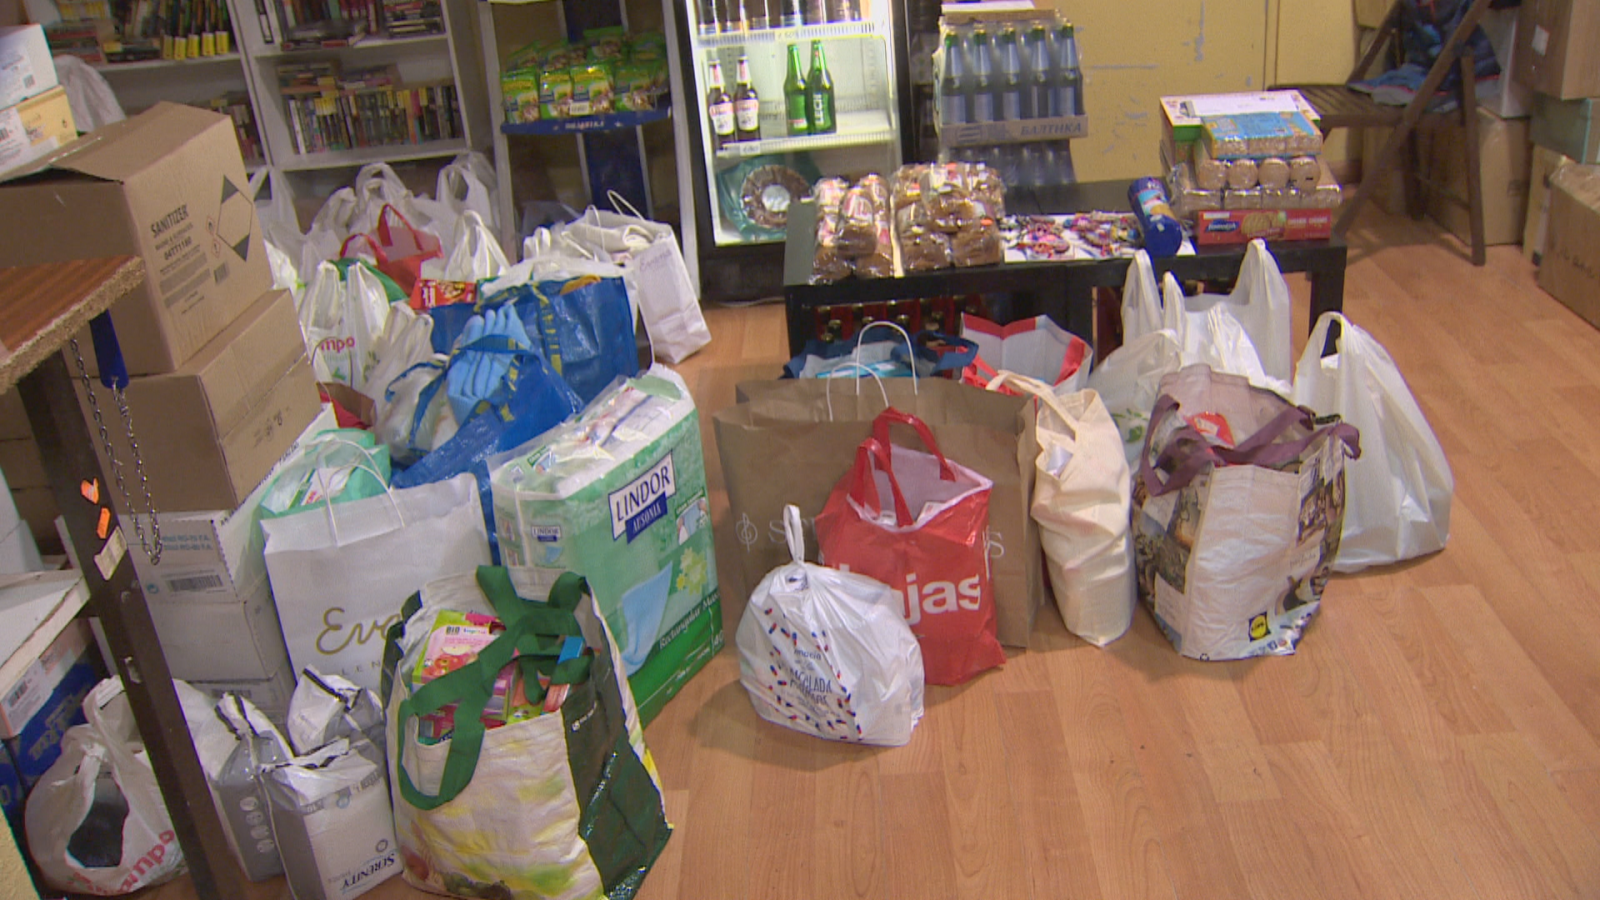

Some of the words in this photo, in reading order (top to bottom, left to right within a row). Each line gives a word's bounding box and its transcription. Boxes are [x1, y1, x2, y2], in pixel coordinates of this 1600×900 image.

[150, 204, 190, 239] SANITIZER
[616, 464, 671, 523] LINDOR
[660, 607, 701, 651] Rectangular
[340, 852, 396, 891] SERENITY
